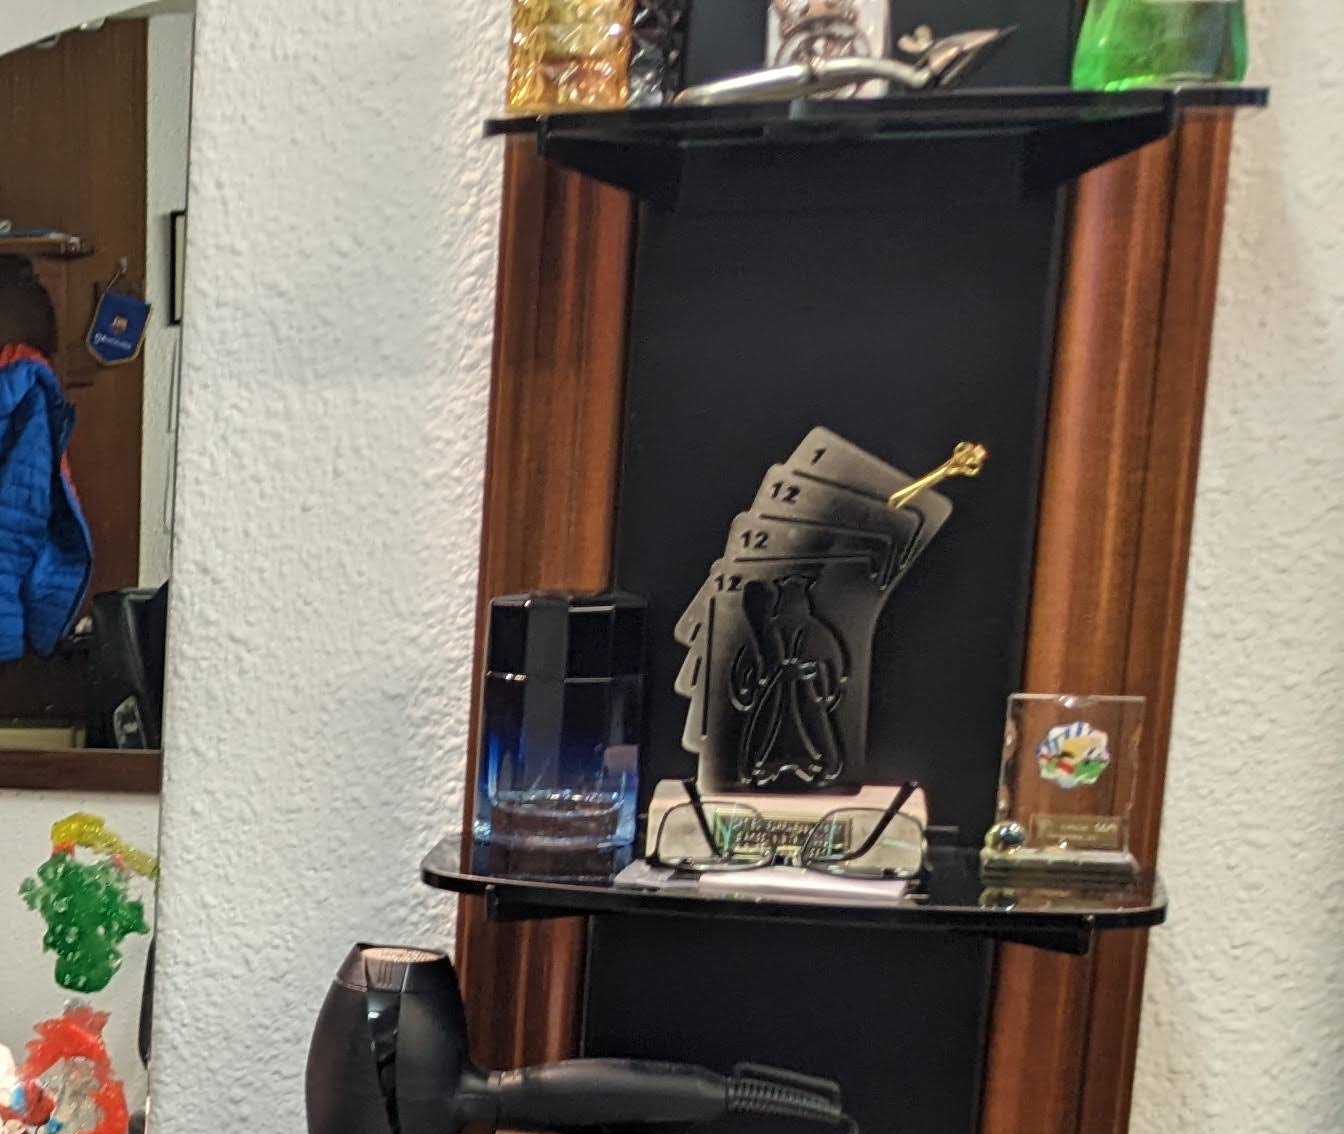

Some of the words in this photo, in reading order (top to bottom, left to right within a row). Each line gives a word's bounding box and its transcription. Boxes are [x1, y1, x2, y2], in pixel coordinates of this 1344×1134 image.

[769, 481, 800, 504] 12
[740, 530, 769, 549] 12
[714, 575, 743, 592] 12
